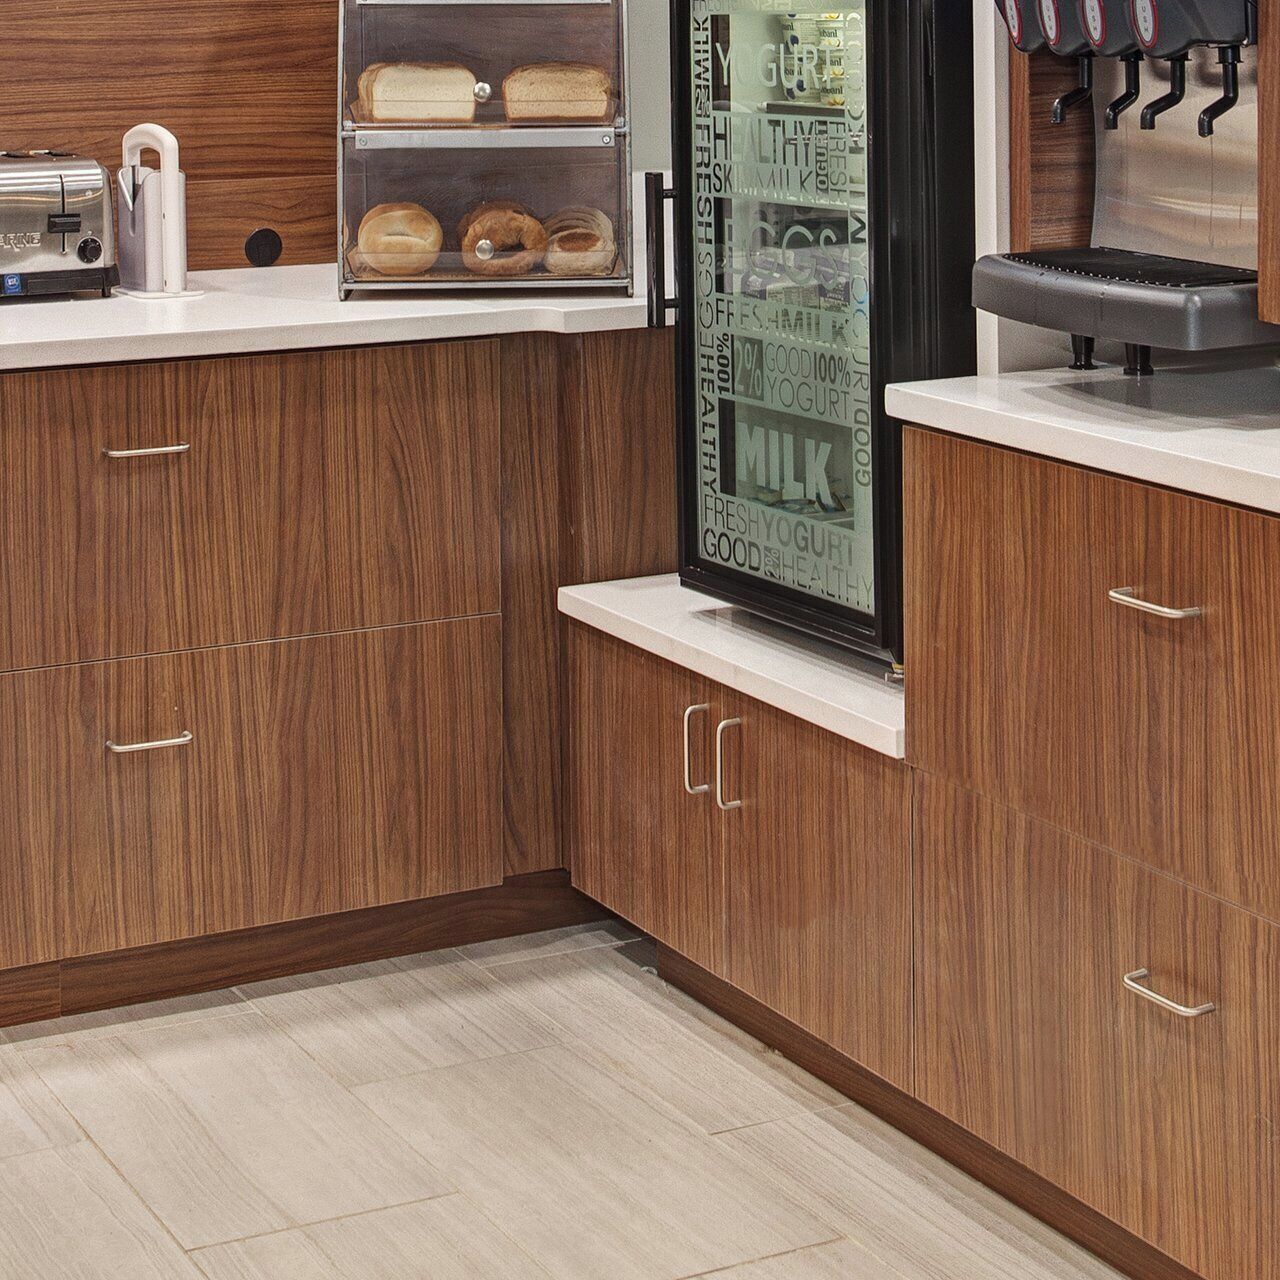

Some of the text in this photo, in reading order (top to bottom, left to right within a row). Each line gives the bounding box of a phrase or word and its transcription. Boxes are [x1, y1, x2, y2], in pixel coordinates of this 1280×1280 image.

[693, 16, 710, 86] MILK
[716, 41, 833, 90] YOGURT
[695, 124, 712, 245] FRESH
[713, 163, 754, 195] SKI
[698, 251, 714, 349] EGGS
[717, 332, 731, 396] 100%
[765, 342, 851, 388] GOOD 100%
[766, 375, 850, 419] YOGURT
[700, 354, 717, 495] HEALTHY
[853, 407, 871, 488] GOOD
[736, 421, 832, 509] MILK
[704, 494, 855, 567] FRESH YOGURT
[703, 528, 762, 572] GOOD
[782, 551, 873, 609] HEALTHY
